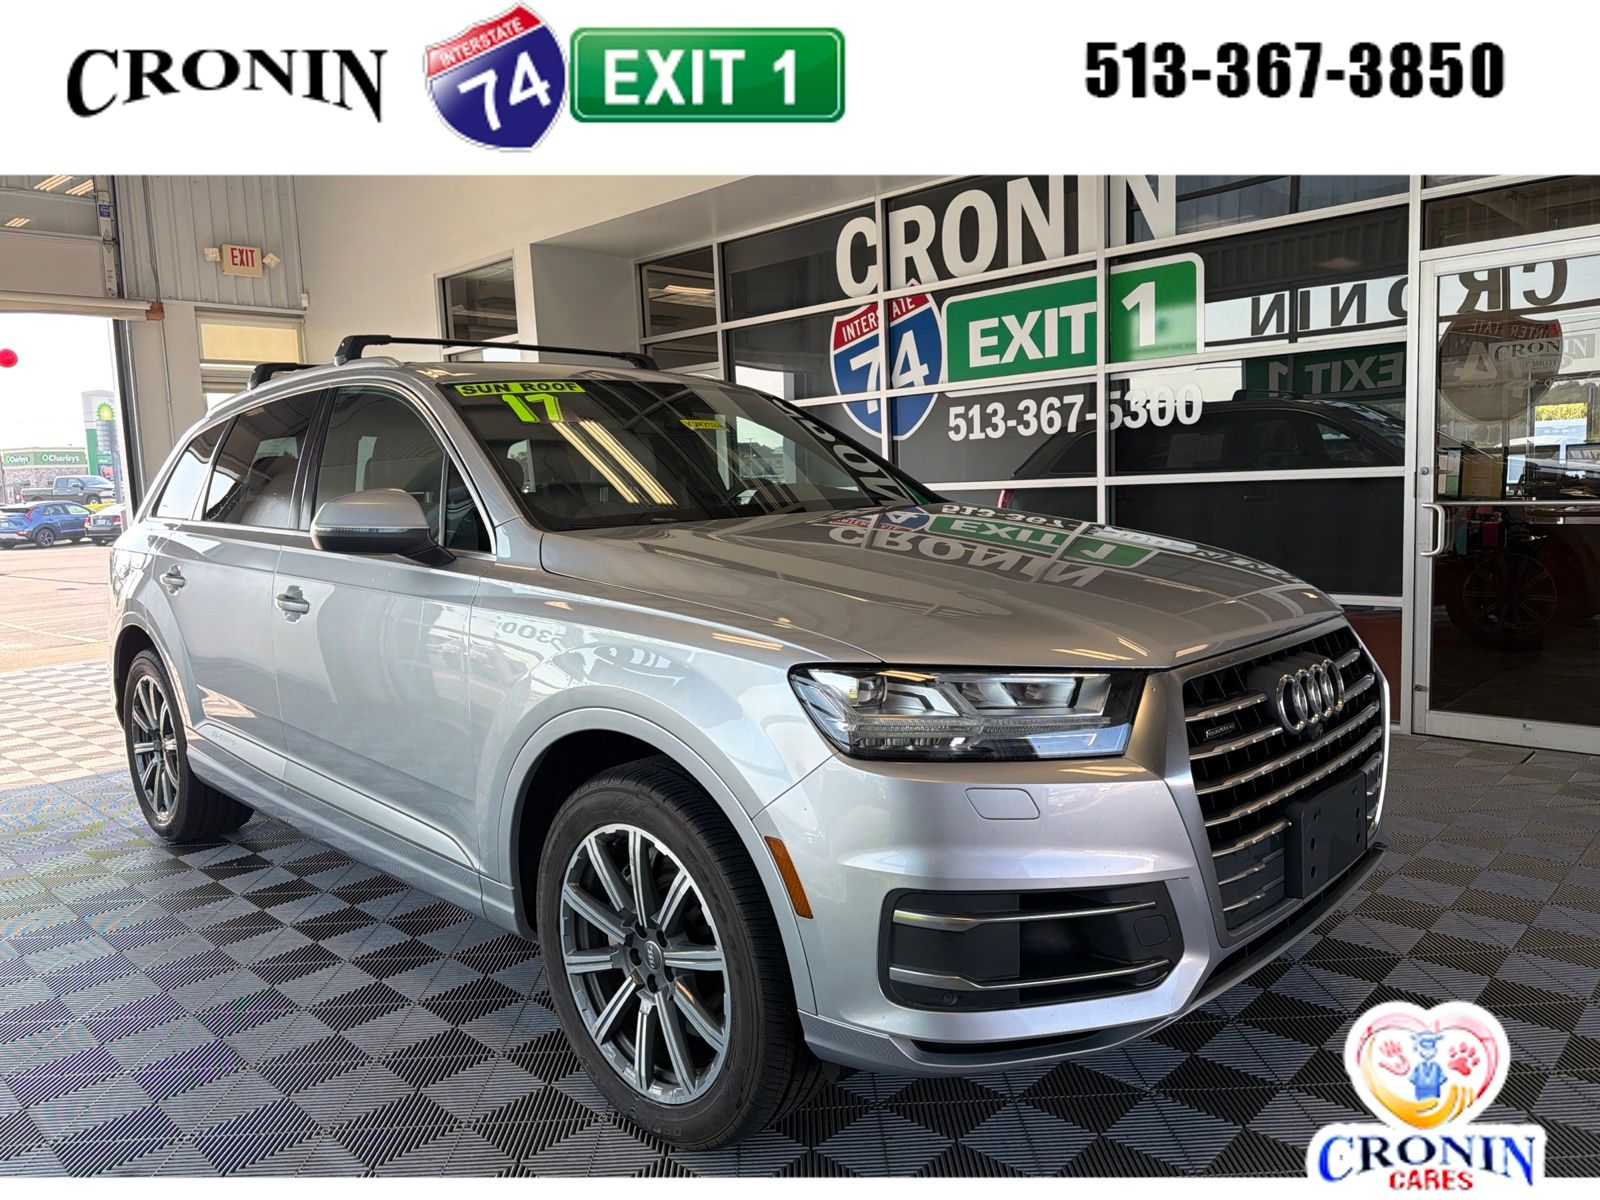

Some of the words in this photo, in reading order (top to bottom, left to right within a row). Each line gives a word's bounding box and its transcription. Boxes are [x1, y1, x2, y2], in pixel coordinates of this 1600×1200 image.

[230, 247, 256, 269] EXIT
[836, 174, 1177, 298] CRONIN
[841, 295, 917, 343] INTERATE
[968, 301, 1097, 368] EXIT
[1120, 281, 1156, 347] 1
[461, 383, 511, 395] SUN
[519, 382, 579, 392] ROOF
[849, 329, 931, 415] 74
[501, 393, 565, 423] 17
[948, 383, 1204, 442] 513-367-5300
